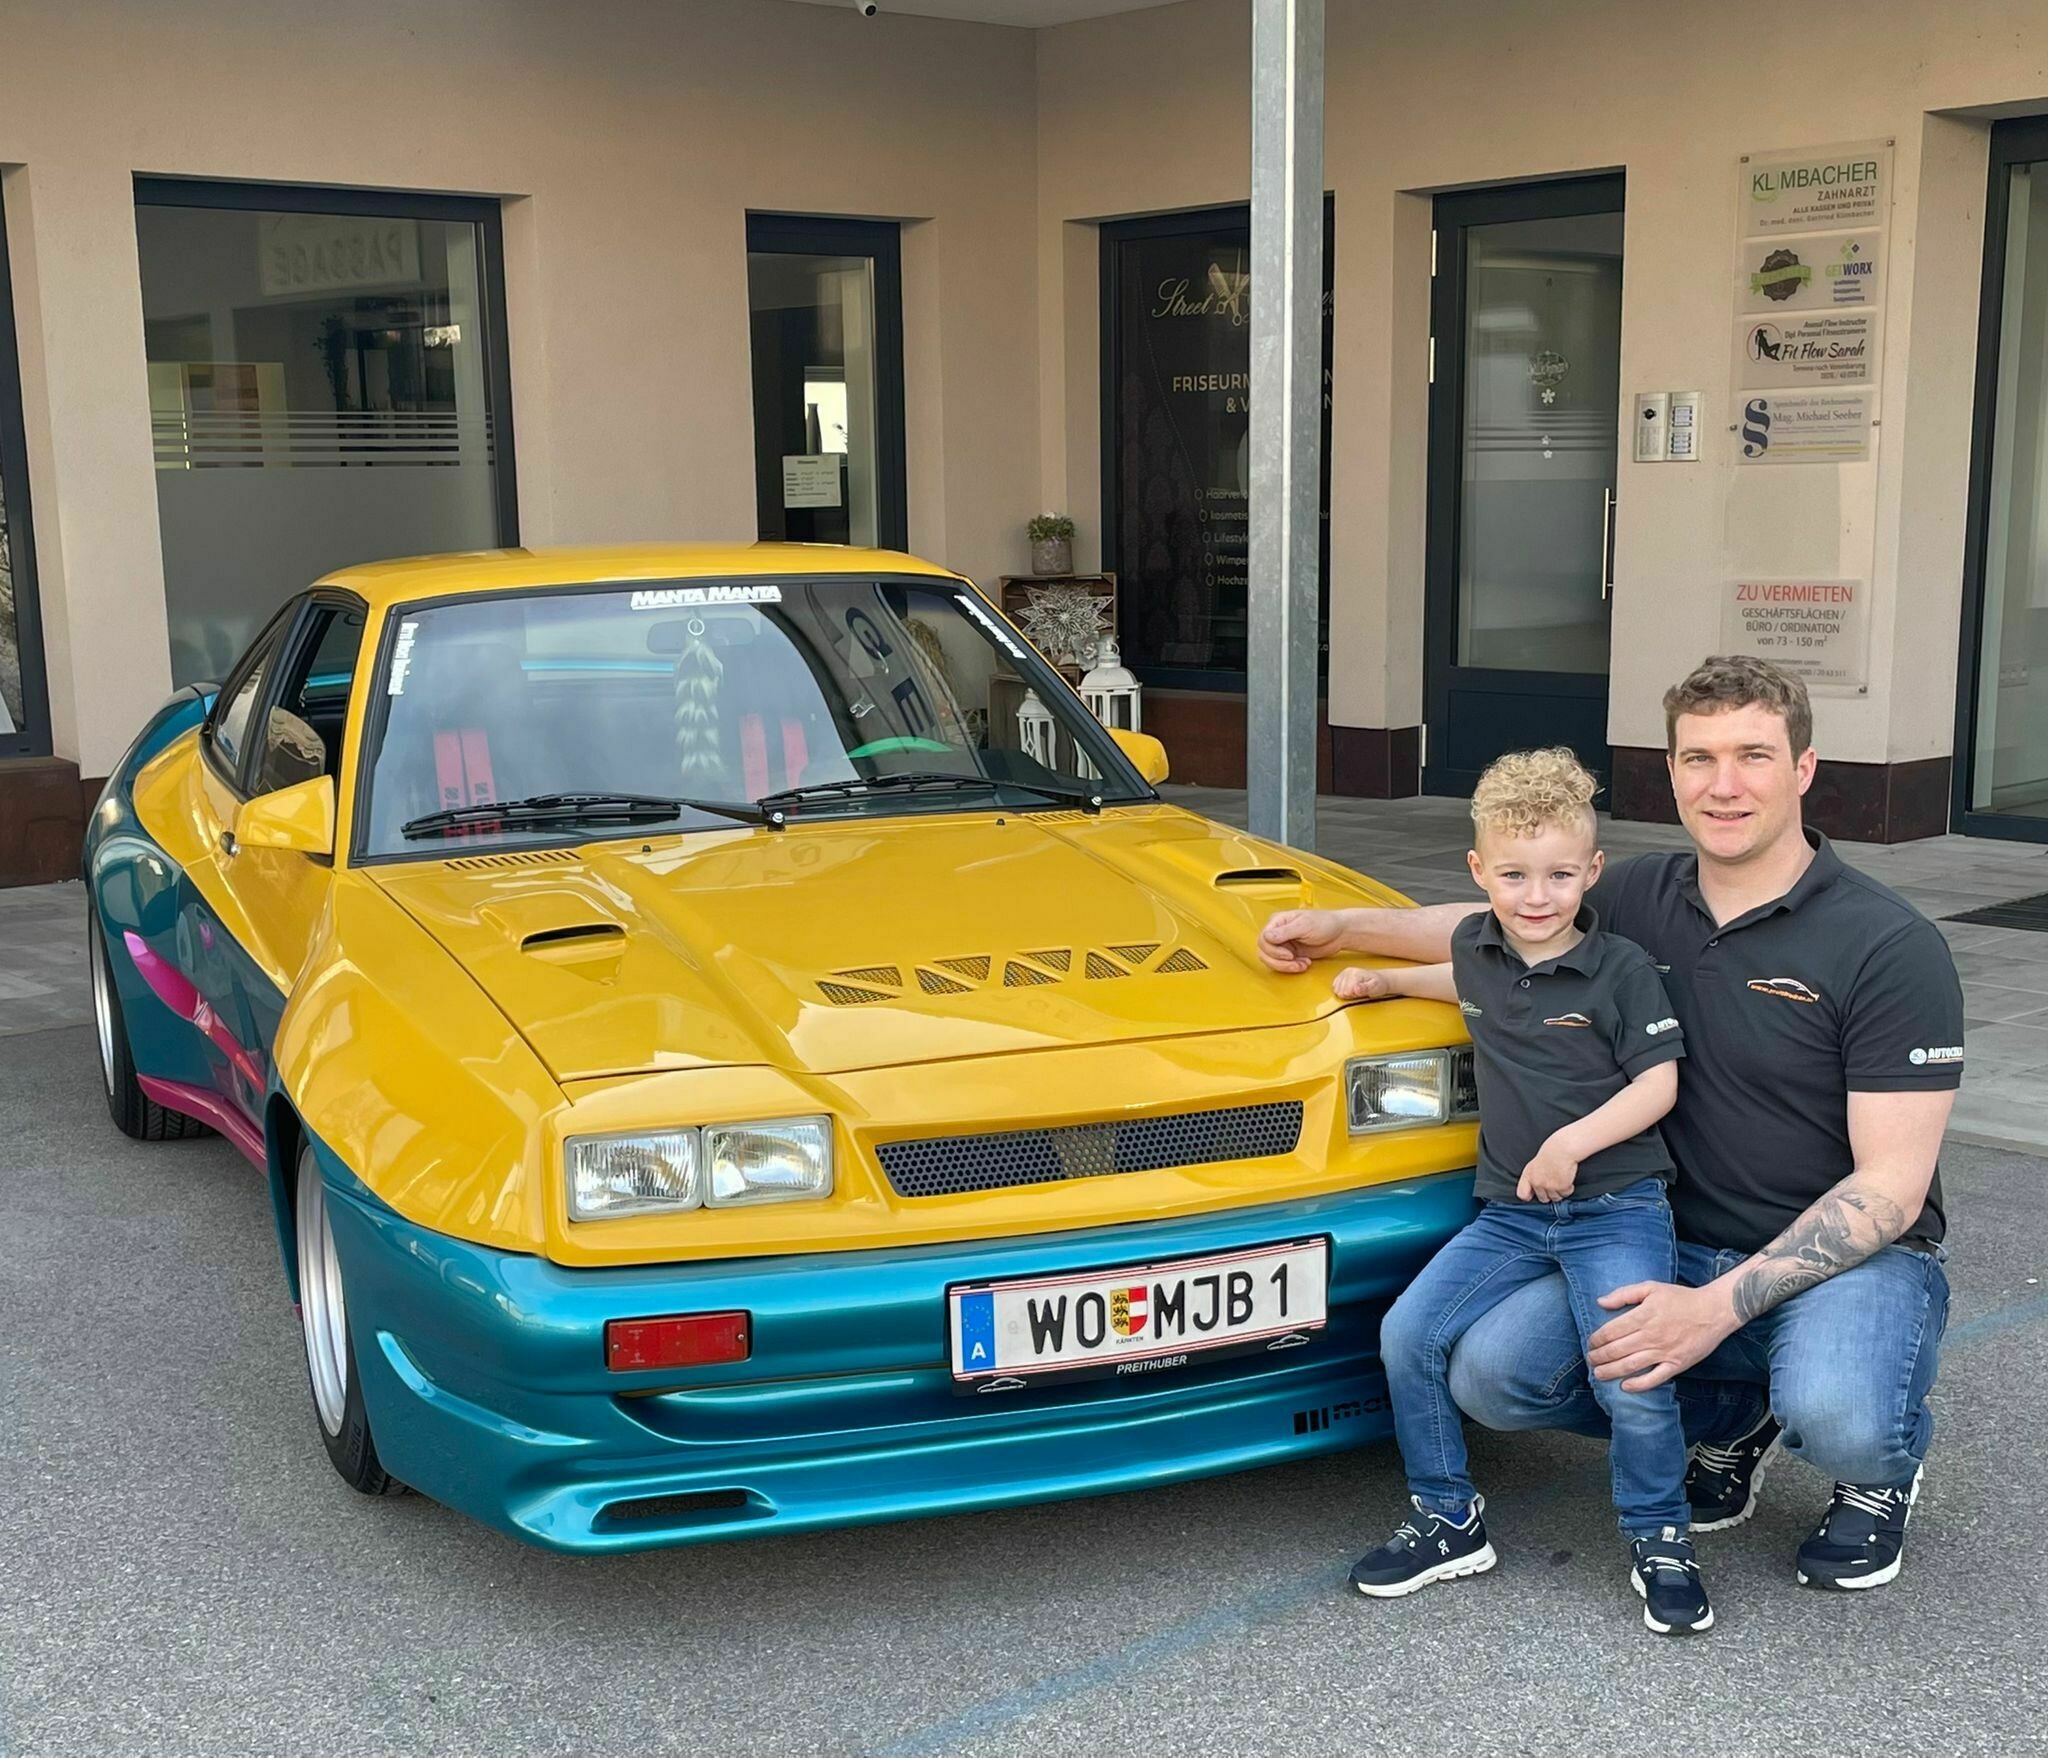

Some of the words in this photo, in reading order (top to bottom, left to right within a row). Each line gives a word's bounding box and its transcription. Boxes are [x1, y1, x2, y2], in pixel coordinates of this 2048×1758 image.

[1817, 186, 1876, 201] ZAHNARZT
[1810, 204, 1835, 212] KASSEN
[1837, 202, 1851, 210] UND
[1853, 200, 1875, 208] PRIVAT
[1825, 262, 1873, 277] GETWORX
[1152, 278, 1215, 318] Street
[1782, 343, 1798, 360] Fit
[1801, 341, 1828, 359] Flow
[1828, 339, 1864, 358] Sarah
[1226, 397, 1236, 413] &
[1796, 410, 1830, 421] Michael
[631, 588, 706, 608] MANTA
[708, 586, 781, 602] MANTA
[1736, 584, 1758, 601] ZU
[1762, 585, 1853, 602] VERMIETEN
[1741, 607, 1839, 620] GESCHÄFTSFLÄCHEN
[1746, 620, 1772, 632] BÜRO
[1780, 622, 1840, 633] ORDINATION
[1757, 637, 1774, 646] von
[1777, 636, 1788, 646] 73
[1796, 637, 1813, 647] 150
[971, 1342, 987, 1360] A
[1027, 1291, 1106, 1355] WO
[1153, 1270, 1254, 1340] MJB
[1270, 1263, 1288, 1318] 1
[1116, 1336, 1144, 1345] KÄRNTEN
[1116, 1355, 1188, 1375] PREITHUBER
